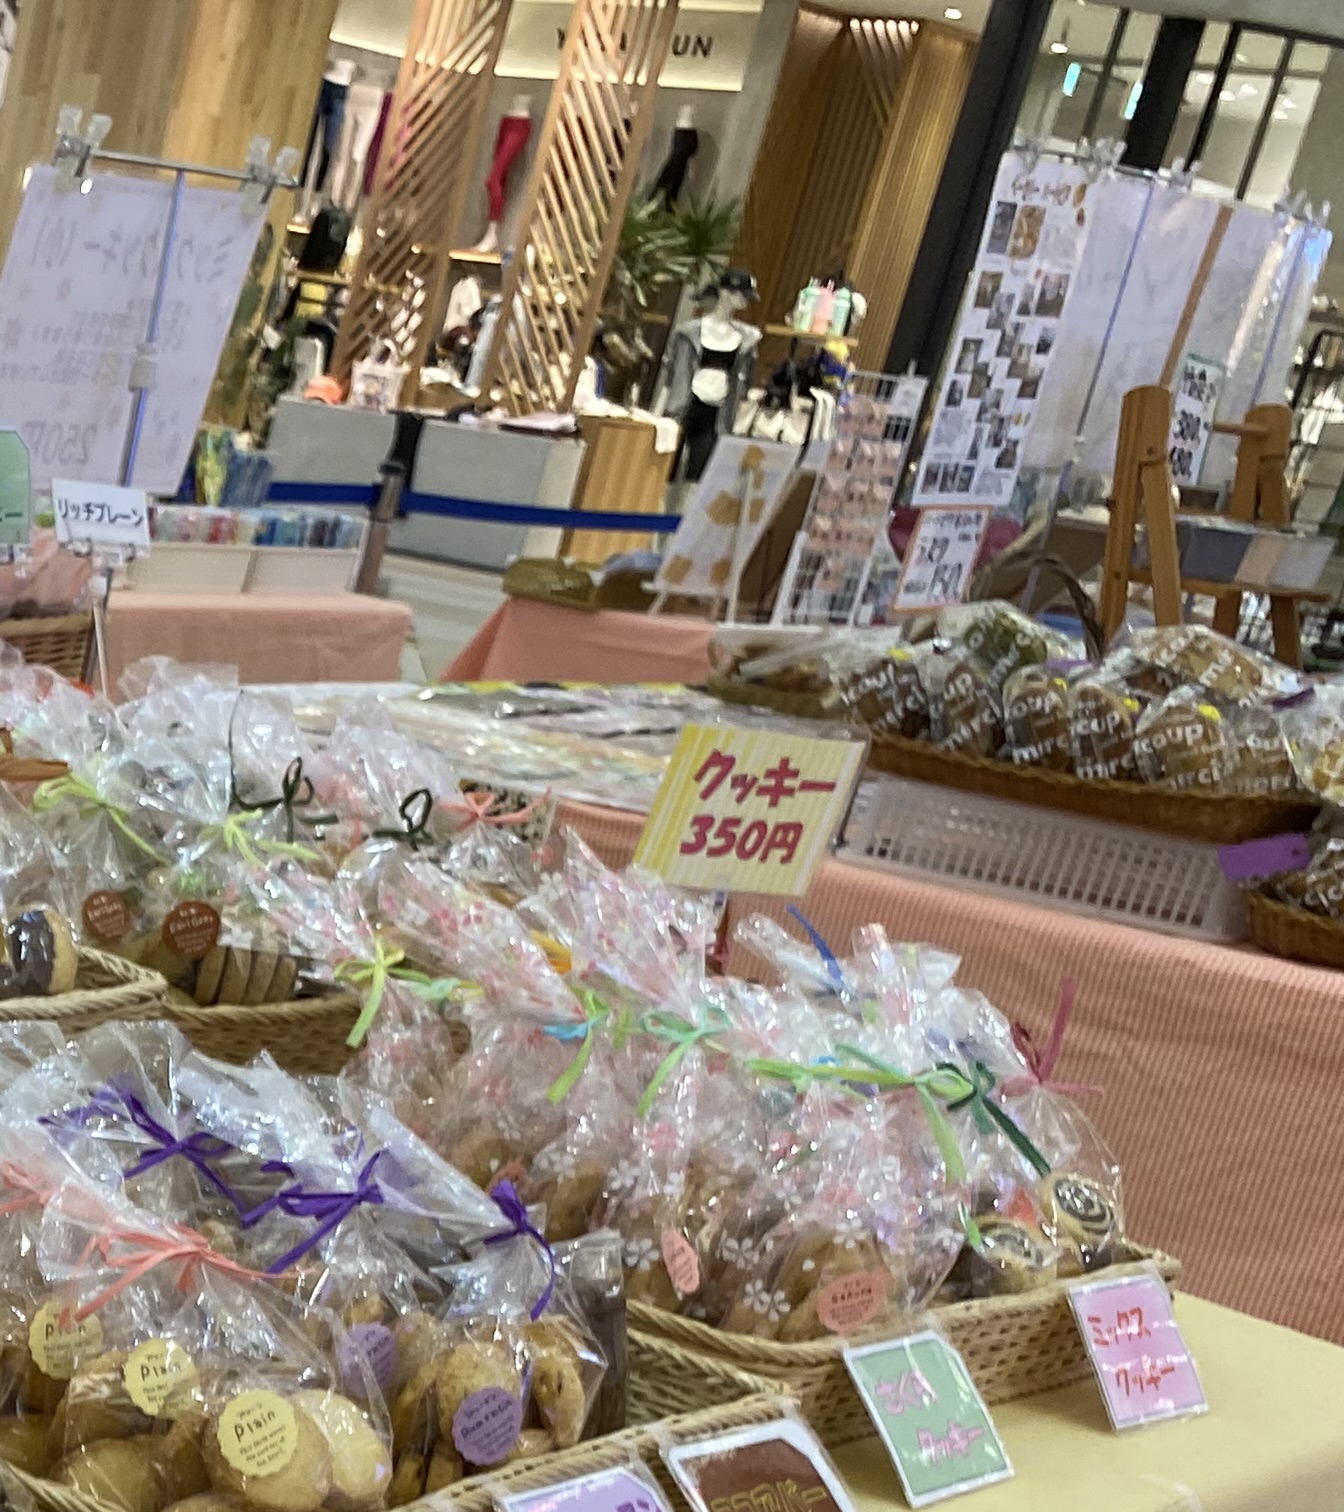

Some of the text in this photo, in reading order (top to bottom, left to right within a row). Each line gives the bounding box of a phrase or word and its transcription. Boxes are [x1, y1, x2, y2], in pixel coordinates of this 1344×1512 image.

[57, 498, 144, 528] リッチプレーン
[692, 747, 836, 808] クッキー
[679, 816, 804, 864] 350円
[233, 1410, 277, 1443] Plain
